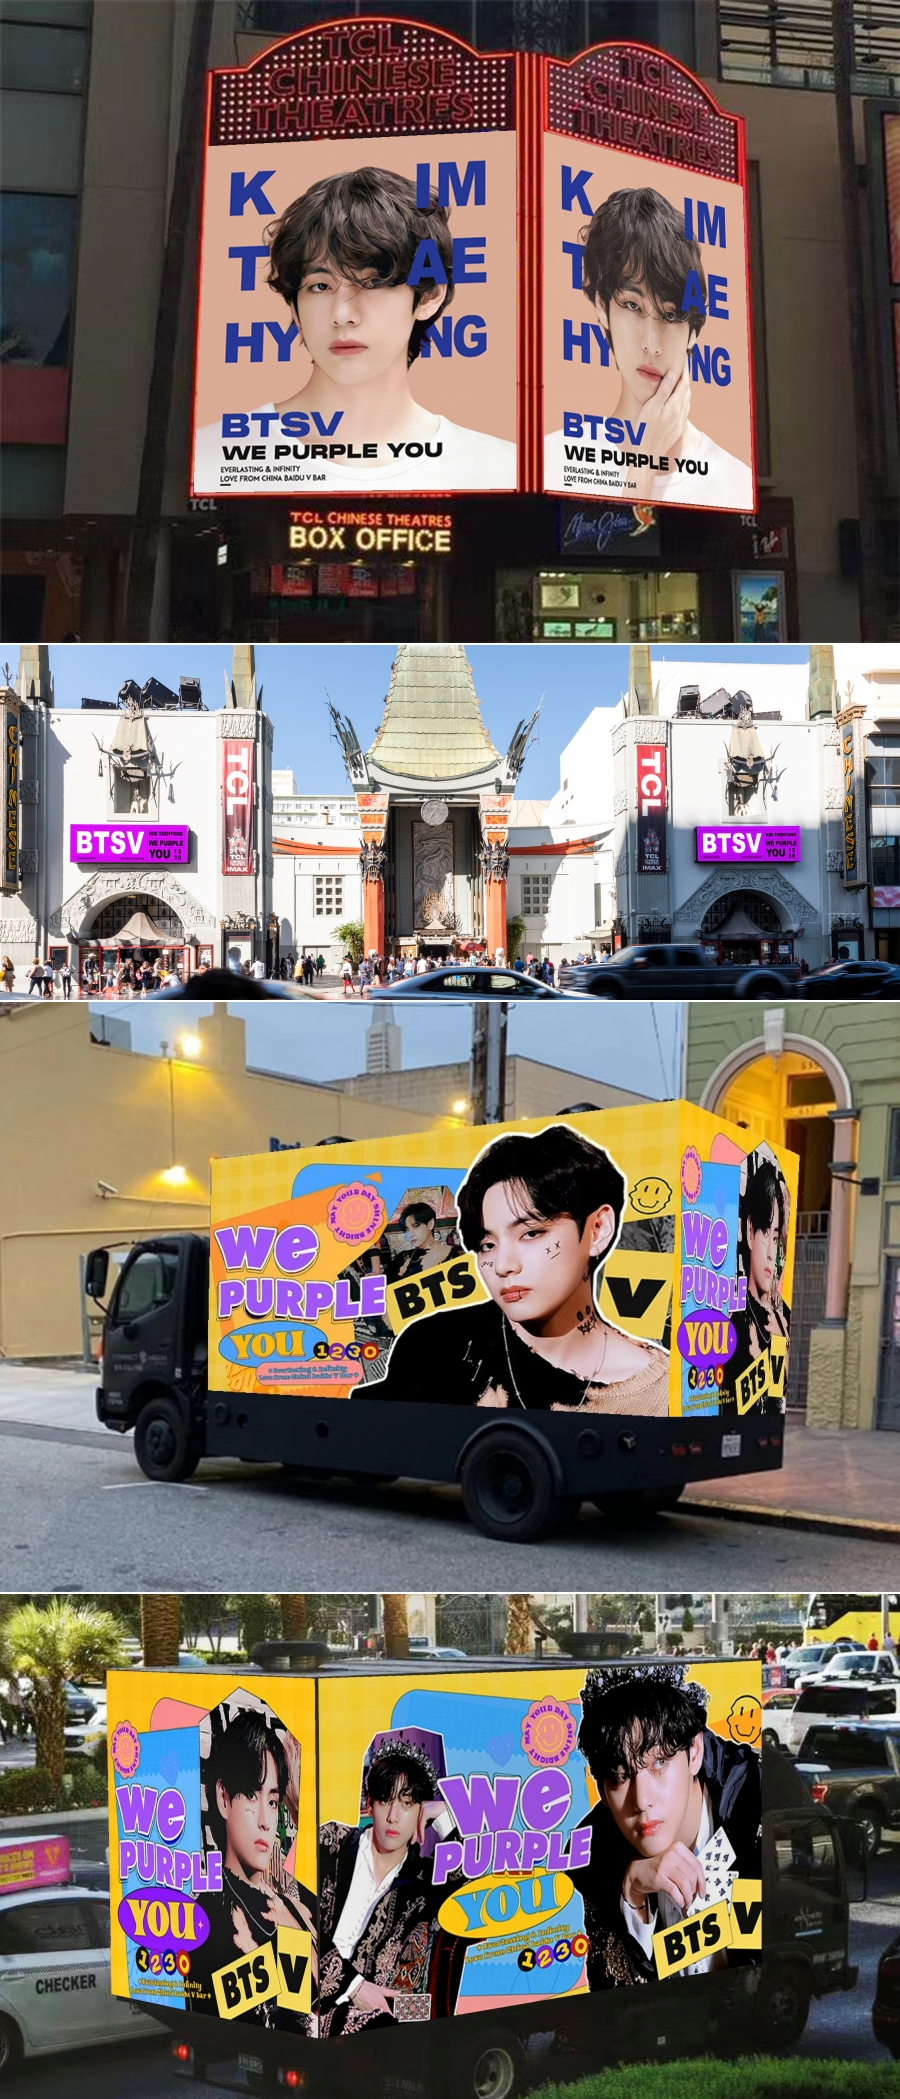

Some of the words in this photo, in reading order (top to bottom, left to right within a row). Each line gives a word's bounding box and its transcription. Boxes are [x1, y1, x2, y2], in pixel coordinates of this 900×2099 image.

[322, 28, 402, 59] TCL
[269, 58, 455, 96] CHINESE
[620, 53, 677, 92] TCL
[249, 92, 474, 131] THEATRES
[585, 74, 710, 135] CHINESE
[573, 103, 721, 170] THEATRES
[229, 170, 277, 217] K
[416, 160, 487, 209] IM
[561, 164, 594, 217] K
[684, 197, 727, 249] IM
[229, 245, 270, 291] T
[406, 237, 487, 287] AE
[562, 240, 586, 290] T
[681, 269, 730, 320] AE
[688, 342, 732, 387] NG
[222, 411, 345, 438] BTSV
[564, 411, 647, 446] BTSV
[222, 445, 267, 460] WE
[274, 443, 378, 460] PURPLE
[387, 442, 443, 458] YOU
[564, 444, 596, 463] WE
[601, 449, 669, 471] PURPLE
[674, 458, 709, 476] YOU
[261, 474, 282, 482] CHINA
[265, 465, 271, 473] &
[273, 465, 301, 473] INFINITY
[564, 466, 595, 476] EVERLASTING
[600, 469, 620, 478] INFINITY
[564, 475, 577, 483] LOVE
[577, 476, 593, 484] FROM
[593, 478, 608, 486] CHINA
[608, 479, 622, 488] BAIDU
[628, 481, 637, 489] BAR
[190, 498, 217, 511] TCL
[290, 512, 323, 524] TCL
[327, 512, 382, 526] CHINESE
[387, 513, 452, 527] THEATRES
[740, 514, 757, 527] TCL
[289, 526, 345, 549] BOX
[356, 527, 451, 551] OFFICE
[8, 725, 18, 871] CHINESE
[226, 747, 249, 816] TCL
[641, 751, 662, 817] TCL
[843, 735, 855, 870] CHINESE
[77, 830, 144, 854] BTSV
[149, 849, 170, 859] YOU
[703, 832, 762, 853] BTSV
[766, 848, 785, 858] YOU
[336, 1188, 360, 1203] YOUR
[361, 1189, 377, 1202] DAY
[365, 1203, 380, 1234] SHINE
[217, 1274, 388, 1321] PURPLE
[393, 1261, 477, 1321] BTS
[605, 1276, 667, 1318] V
[680, 1263, 748, 1313] PURPLE
[230, 1330, 305, 1360] YOU
[315, 1343, 379, 1361] 1230
[684, 1321, 731, 1357] YOU
[740, 1359, 767, 1409] BTS
[771, 1355, 784, 1386] V
[530, 1704, 553, 1719] YOUR
[554, 1706, 569, 1721] DAY
[560, 1722, 573, 1758] SHINE
[119, 1839, 223, 1894] PURPLE
[431, 1825, 593, 1886] PURPLE
[453, 1871, 559, 1933] YOU
[126, 1899, 197, 1941] YOU
[663, 1912, 723, 1967] BTS
[732, 1901, 762, 1935] V
[137, 1949, 190, 1975] 1230
[519, 1936, 588, 1970] 1230
[35, 1973, 97, 1996] CHECKER
[222, 1955, 270, 2010] BTS
[279, 1953, 309, 1994] V
